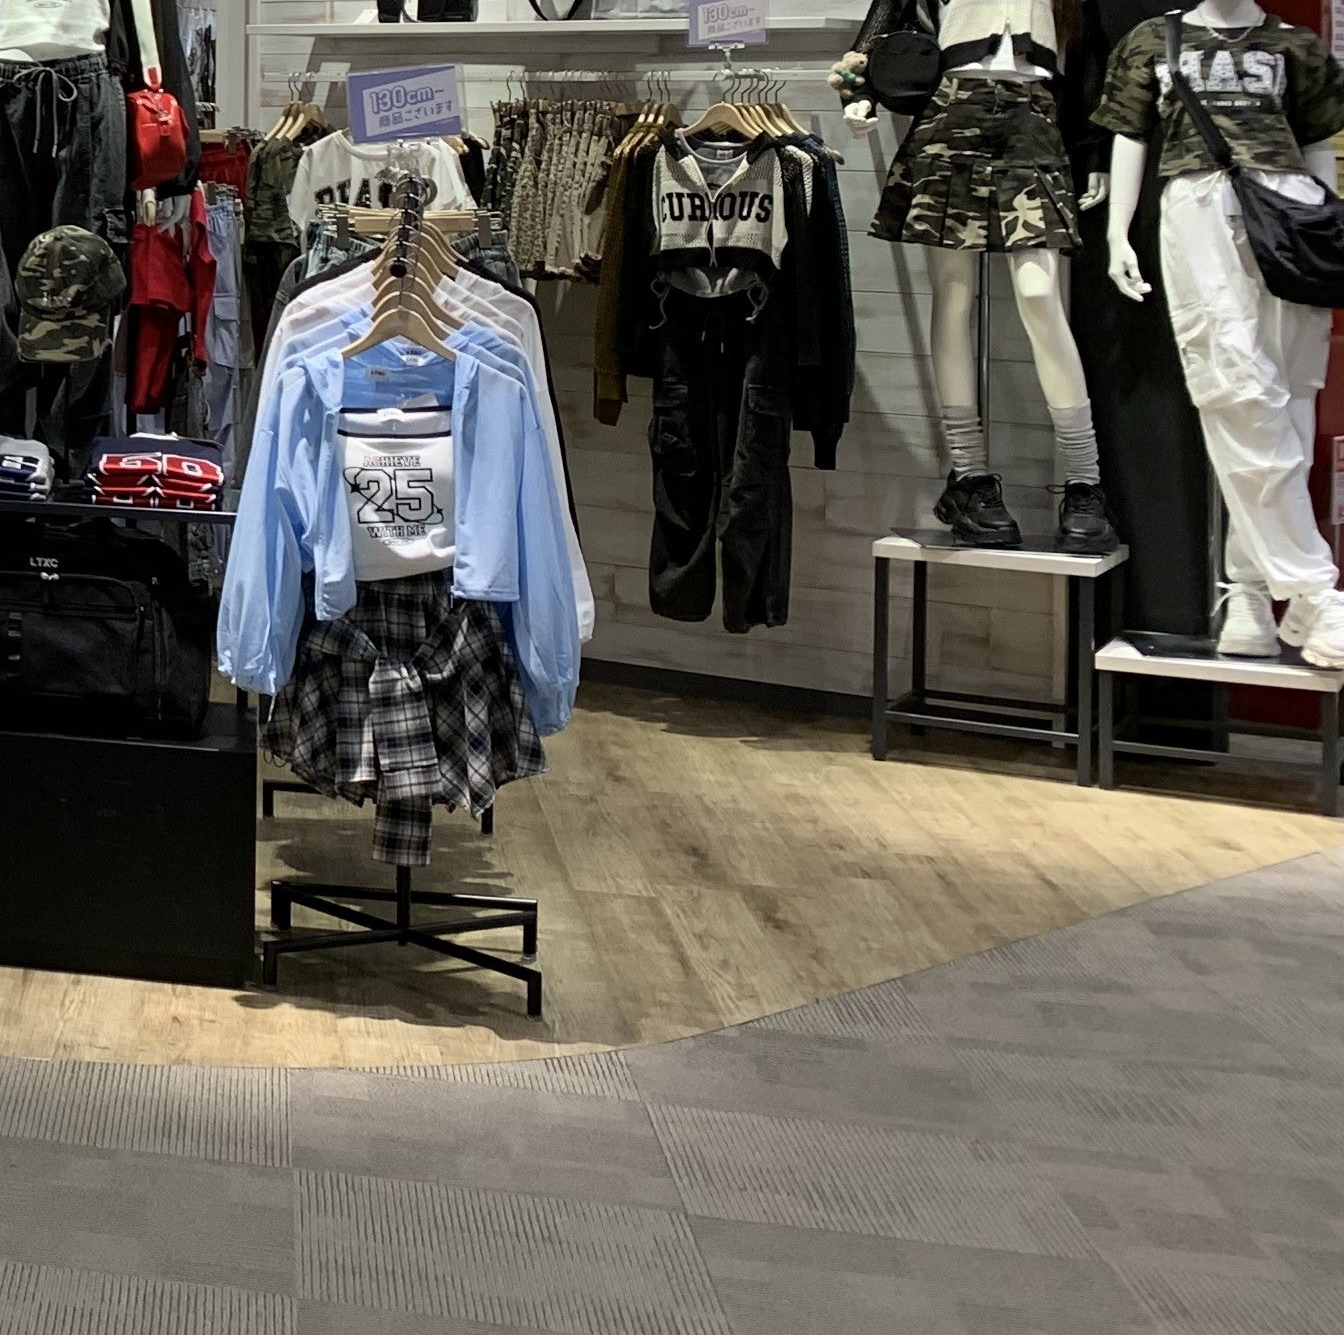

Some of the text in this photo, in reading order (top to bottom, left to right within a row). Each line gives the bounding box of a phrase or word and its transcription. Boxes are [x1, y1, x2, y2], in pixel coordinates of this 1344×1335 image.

[362, 456, 421, 467] ACHIEVE
[353, 468, 434, 524] 25
[367, 525, 427, 539] WITH ME
